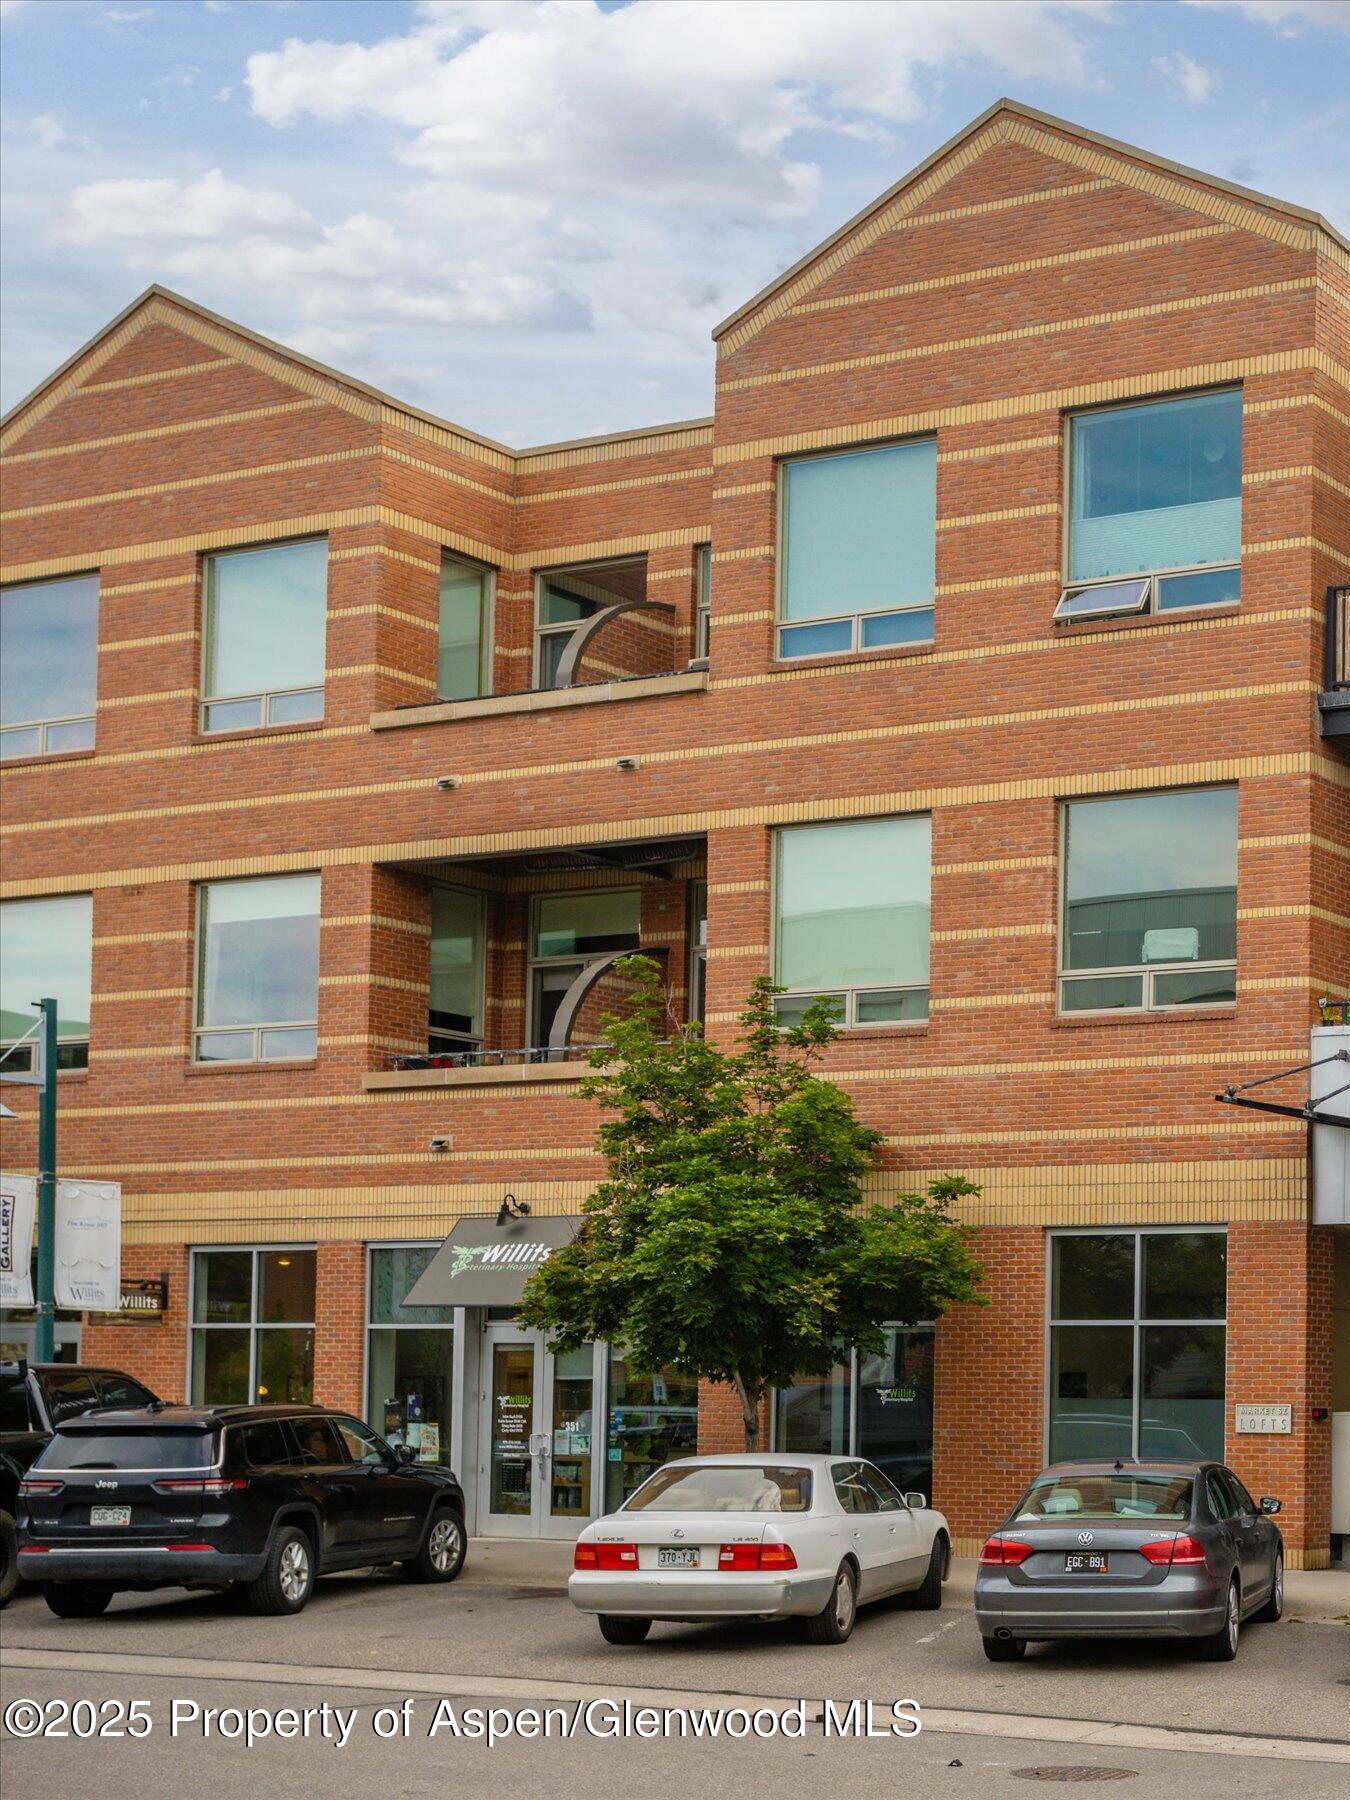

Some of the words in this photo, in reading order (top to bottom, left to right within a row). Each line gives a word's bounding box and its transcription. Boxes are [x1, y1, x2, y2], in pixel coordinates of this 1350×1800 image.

[0, 1199, 11, 1269] GALLERY
[481, 1242, 552, 1263] Willits
[69, 1286, 105, 1300] Willits
[119, 1295, 158, 1309] Willits
[565, 1421, 580, 1432] 351
[1240, 1418, 1288, 1431] LOFTS
[95, 1479, 119, 1490] Jeep
